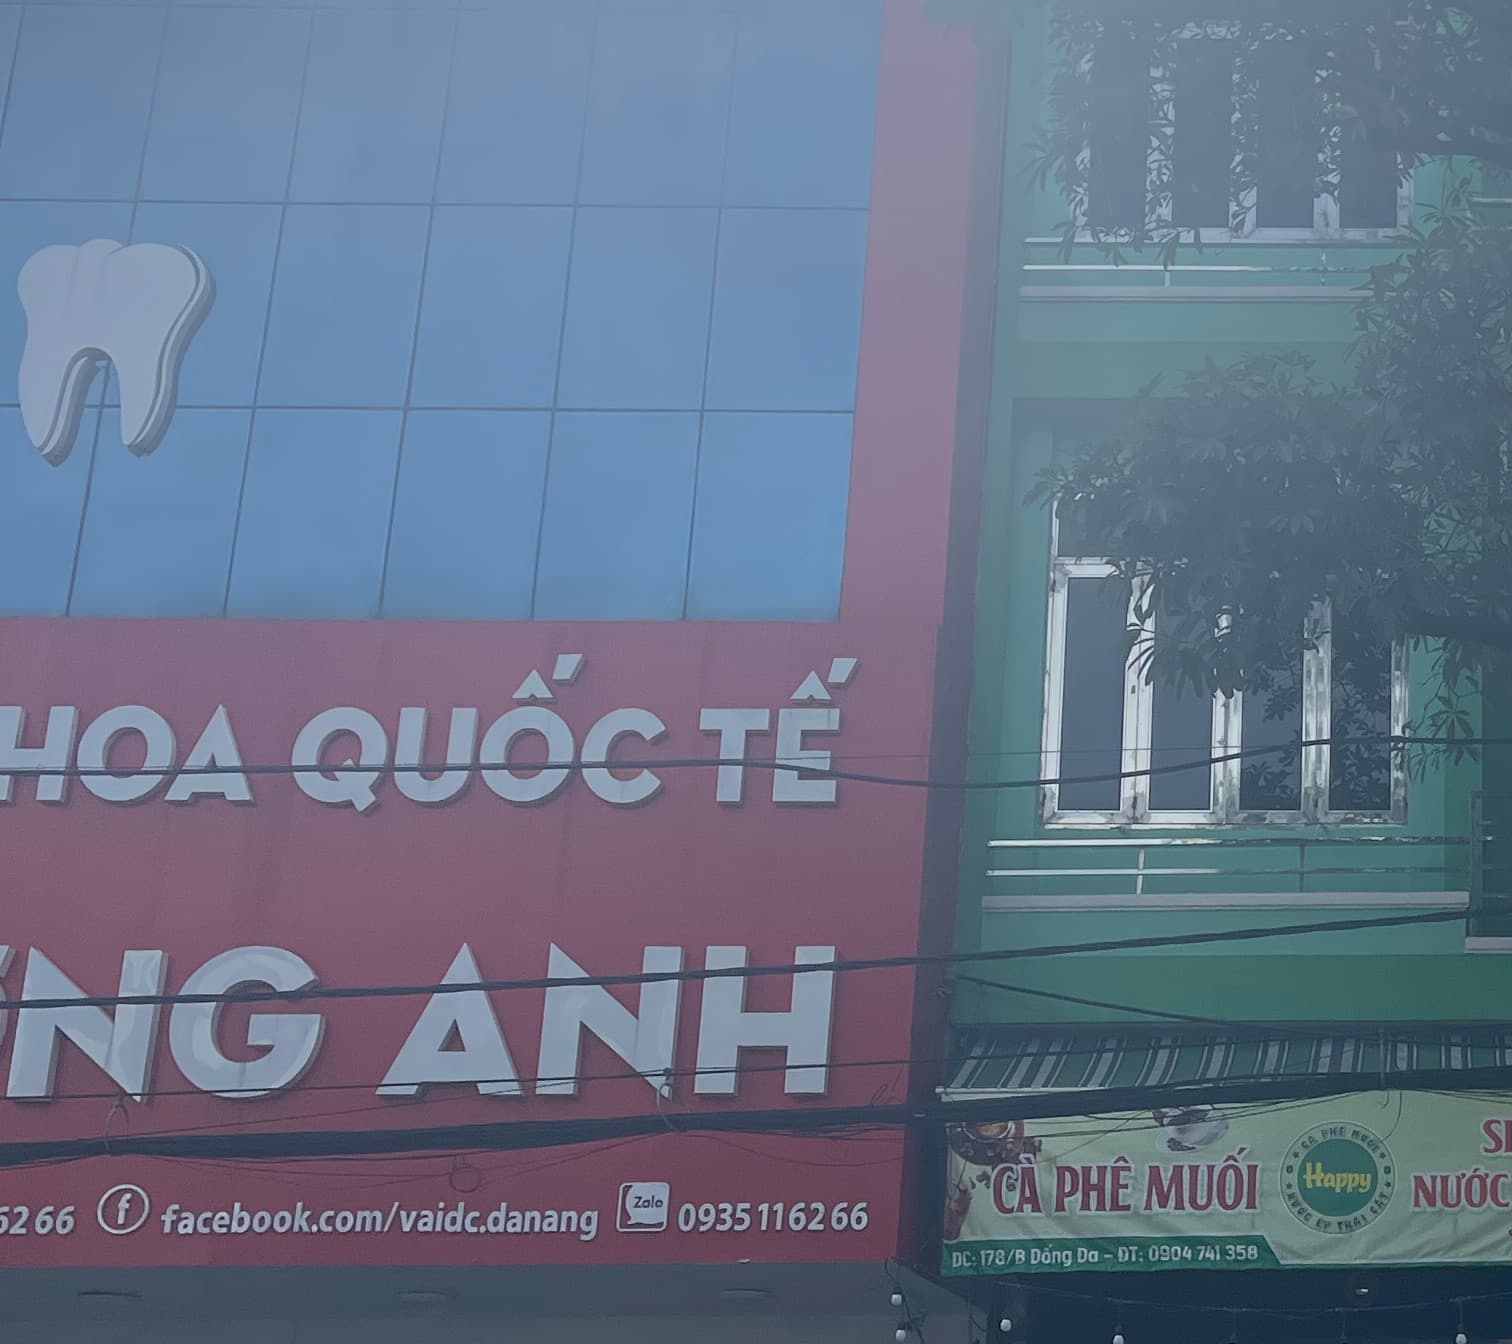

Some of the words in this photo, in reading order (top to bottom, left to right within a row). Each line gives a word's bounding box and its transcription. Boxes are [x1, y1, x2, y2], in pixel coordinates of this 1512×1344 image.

[290, 652, 669, 815] QUỐC
[699, 657, 859, 806] TẾ
[0, 943, 326, 1104] NG
[374, 941, 838, 1101] ANH
[991, 1161, 1041, 1215] CÀ
[1054, 1155, 1131, 1214] PHÊ
[1143, 1144, 1259, 1212] MUỐI
[1303, 1161, 1372, 1193] Happy
[1413, 1164, 1507, 1209] NƯỚC
[161, 1201, 599, 1241] facebook.com/vaidc.danang
[632, 1195, 664, 1210] Zalo
[1148, 1245, 1192, 1262] 0904
[1225, 1244, 1259, 1261] 358
